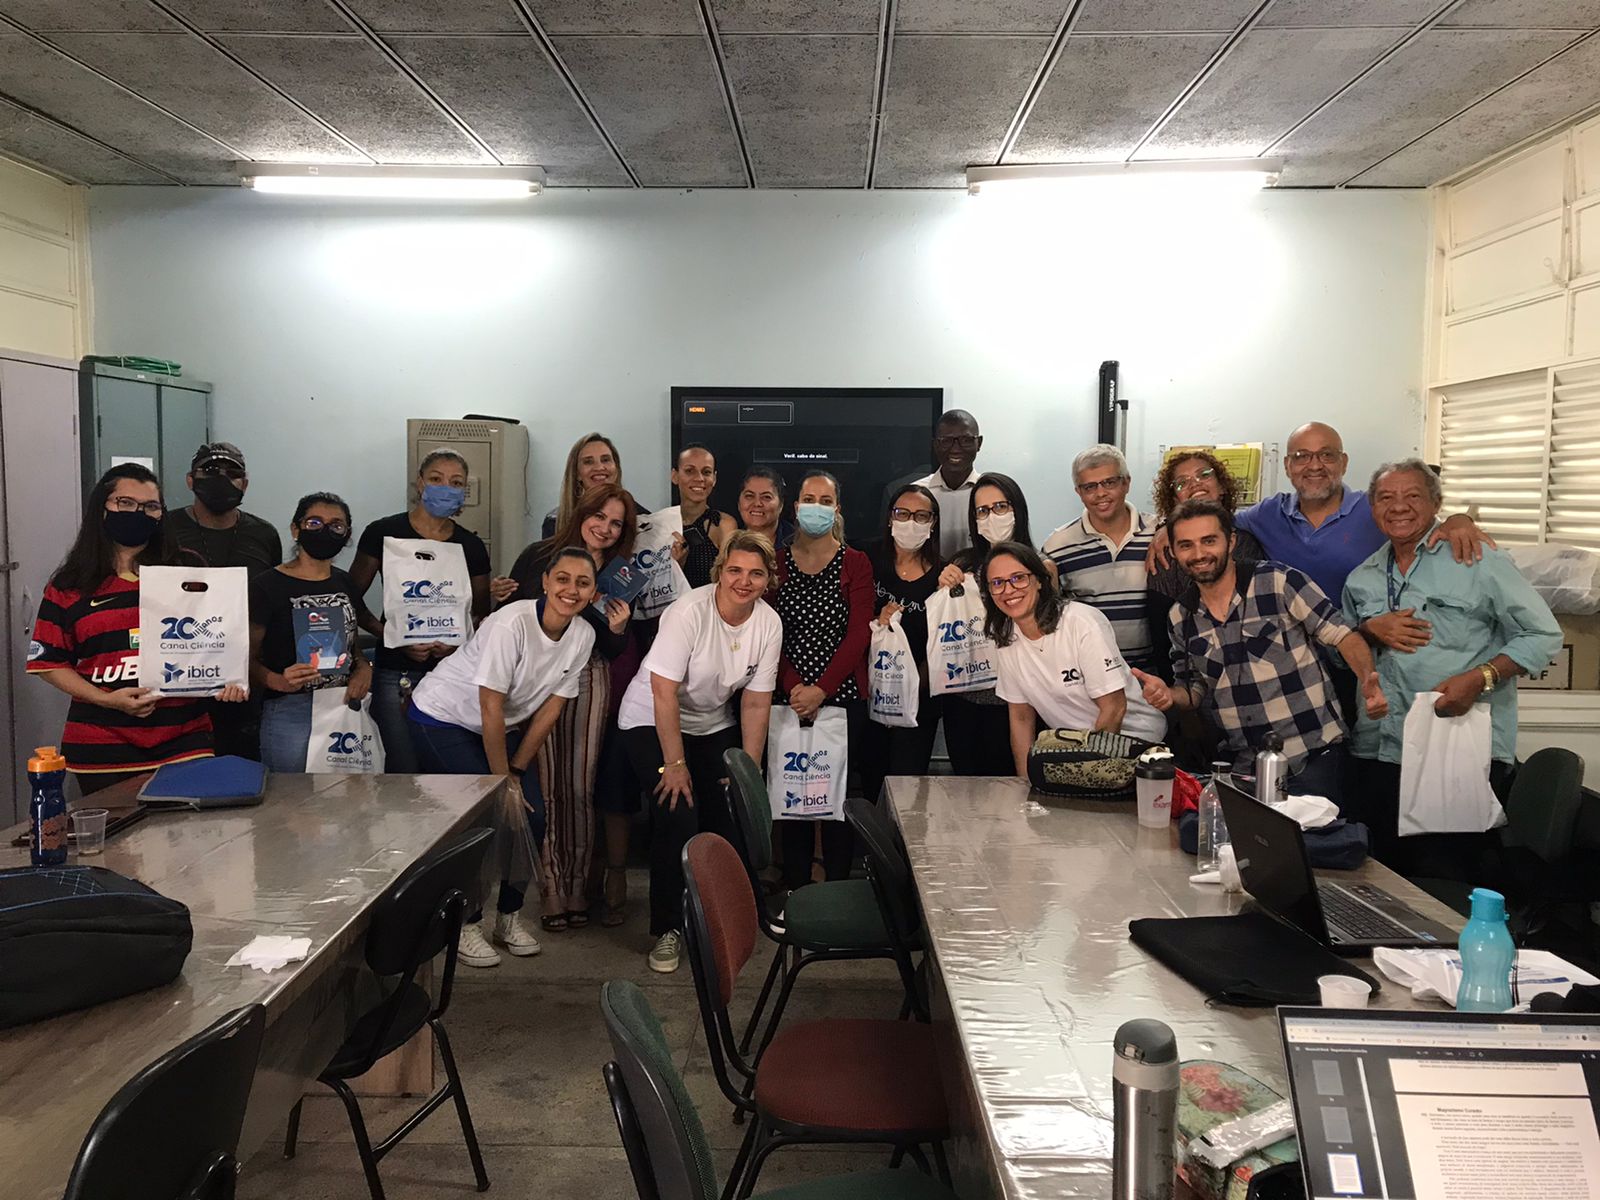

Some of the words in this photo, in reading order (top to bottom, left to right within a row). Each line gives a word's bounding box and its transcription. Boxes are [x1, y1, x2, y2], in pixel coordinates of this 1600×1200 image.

[402, 580, 432, 598] 20
[650, 584, 673, 598] ibict
[160, 616, 195, 640] 20
[202, 615, 223, 629] anos
[427, 616, 455, 627] ibict
[938, 620, 966, 643] 20
[160, 642, 188, 650] Canal
[187, 664, 221, 679] ibict
[965, 659, 991, 674] ibict
[328, 731, 357, 754] 20
[326, 755, 347, 764] Canal
[784, 751, 809, 773] 20
[811, 750, 828, 763] anos
[803, 793, 828, 807] ibict
